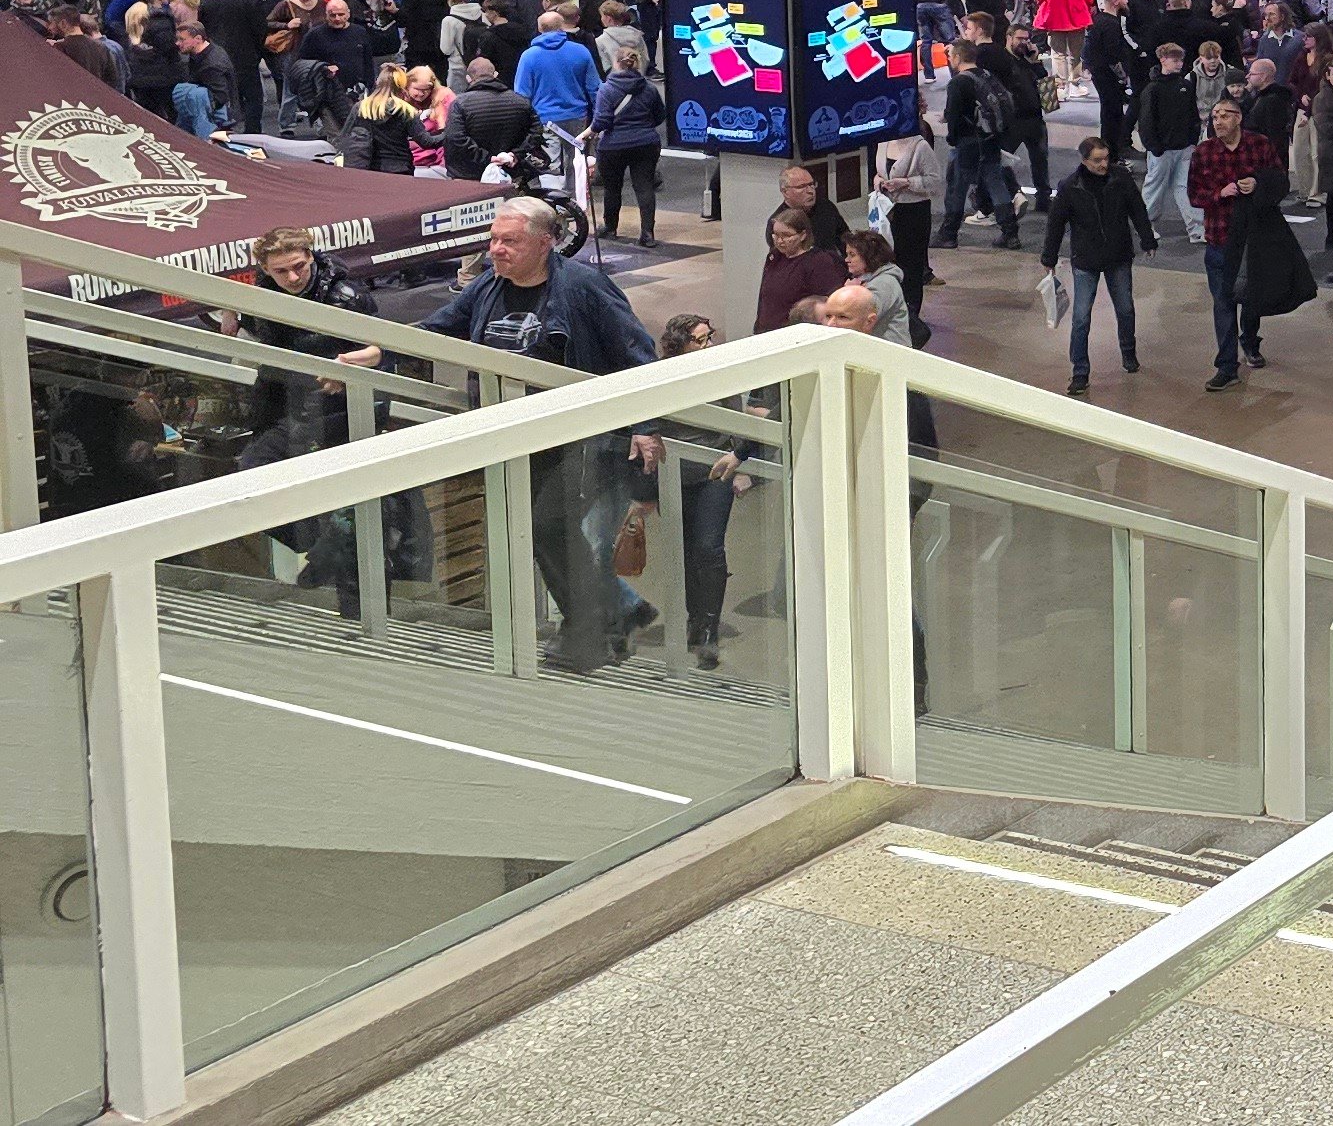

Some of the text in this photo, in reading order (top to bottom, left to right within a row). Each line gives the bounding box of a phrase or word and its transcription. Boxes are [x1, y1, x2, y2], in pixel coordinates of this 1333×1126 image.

[57, 183, 212, 210] KUIVALIHAKUNDI
[460, 202, 495, 215] MADE IN
[460, 213, 496, 226] FINLAND
